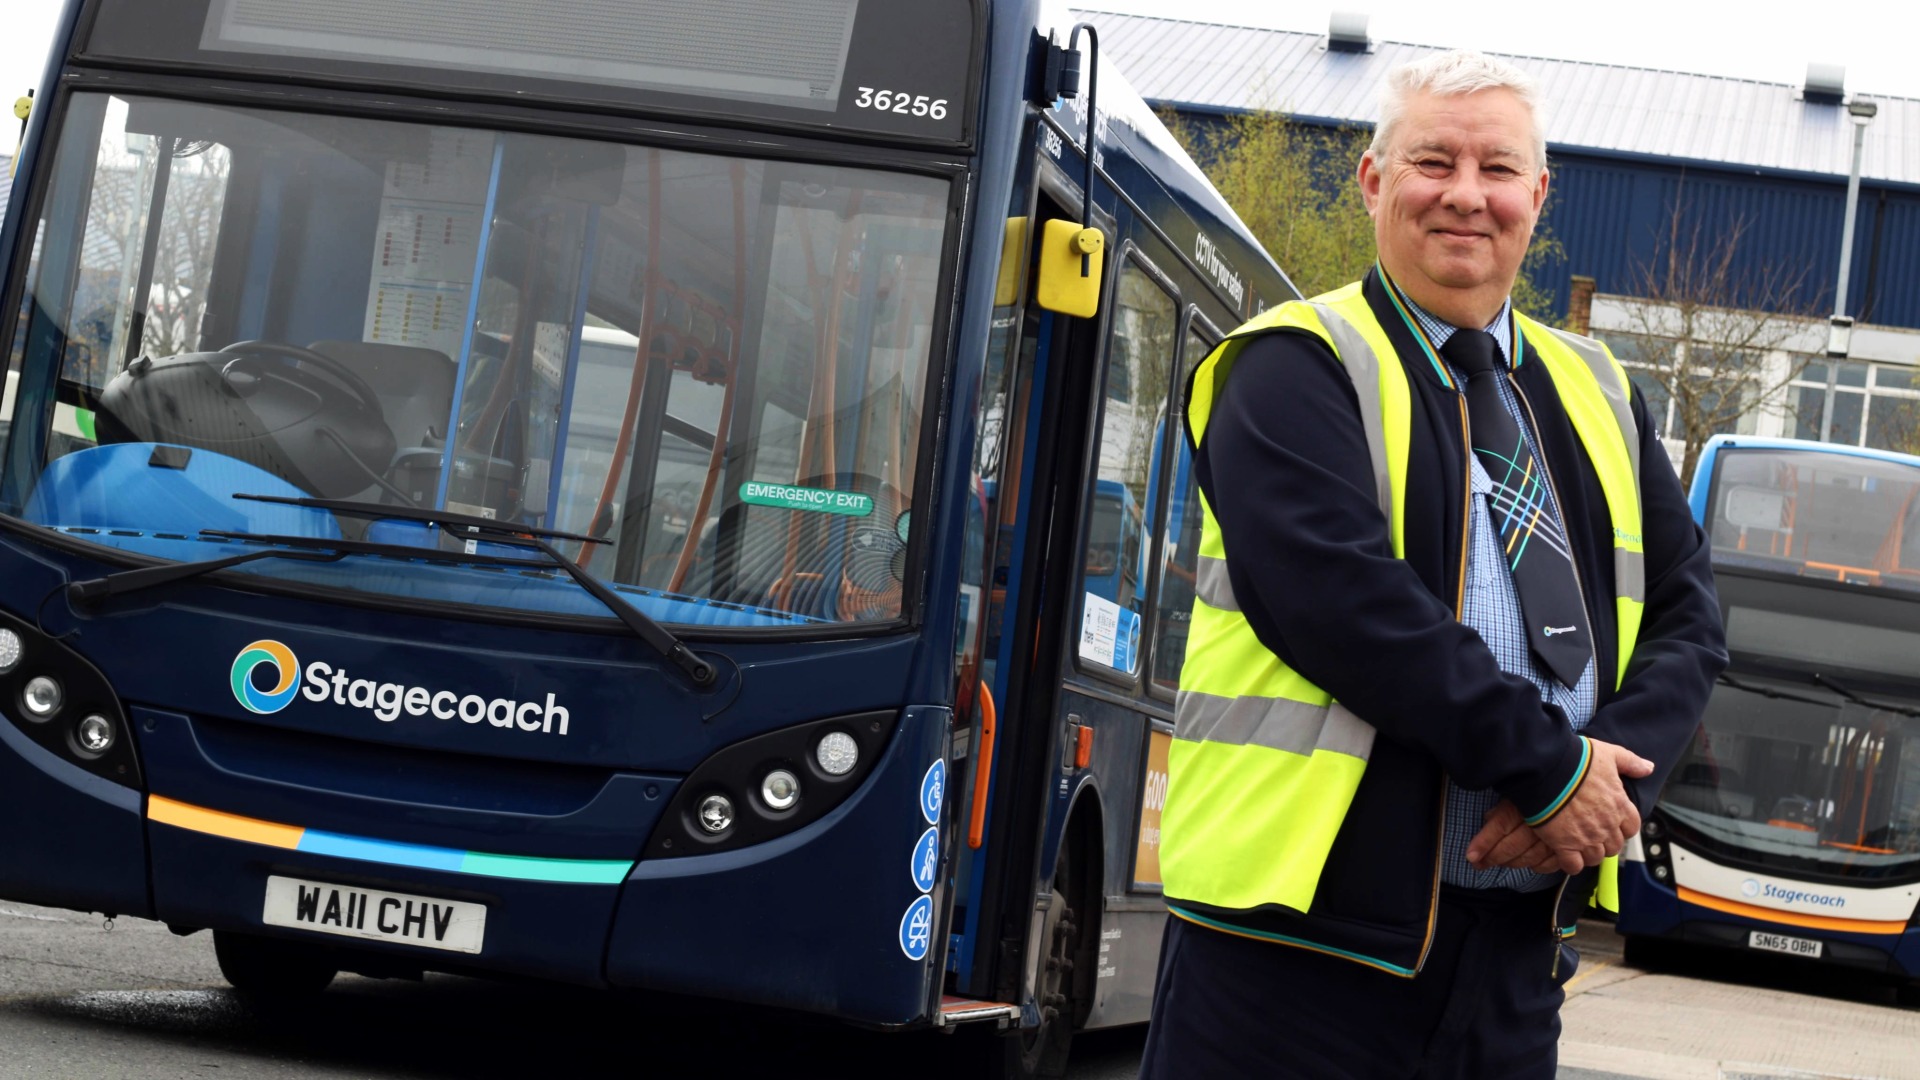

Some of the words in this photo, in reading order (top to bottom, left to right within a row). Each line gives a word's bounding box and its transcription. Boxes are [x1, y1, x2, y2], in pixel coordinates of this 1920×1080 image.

[855, 86, 948, 120] 36256
[1045, 126, 1062, 160] 36256
[1195, 231, 1213, 270] CCTV
[746, 483, 835, 505] EMERGENCY
[836, 493, 867, 509] EXIT
[302, 661, 570, 736] Stagecoach
[296, 884, 367, 930] WA11
[376, 897, 454, 942] CHV
[1763, 884, 1846, 908] Stagecoach
[1755, 934, 1788, 950] SN65
[1791, 940, 1817, 955] OBH
